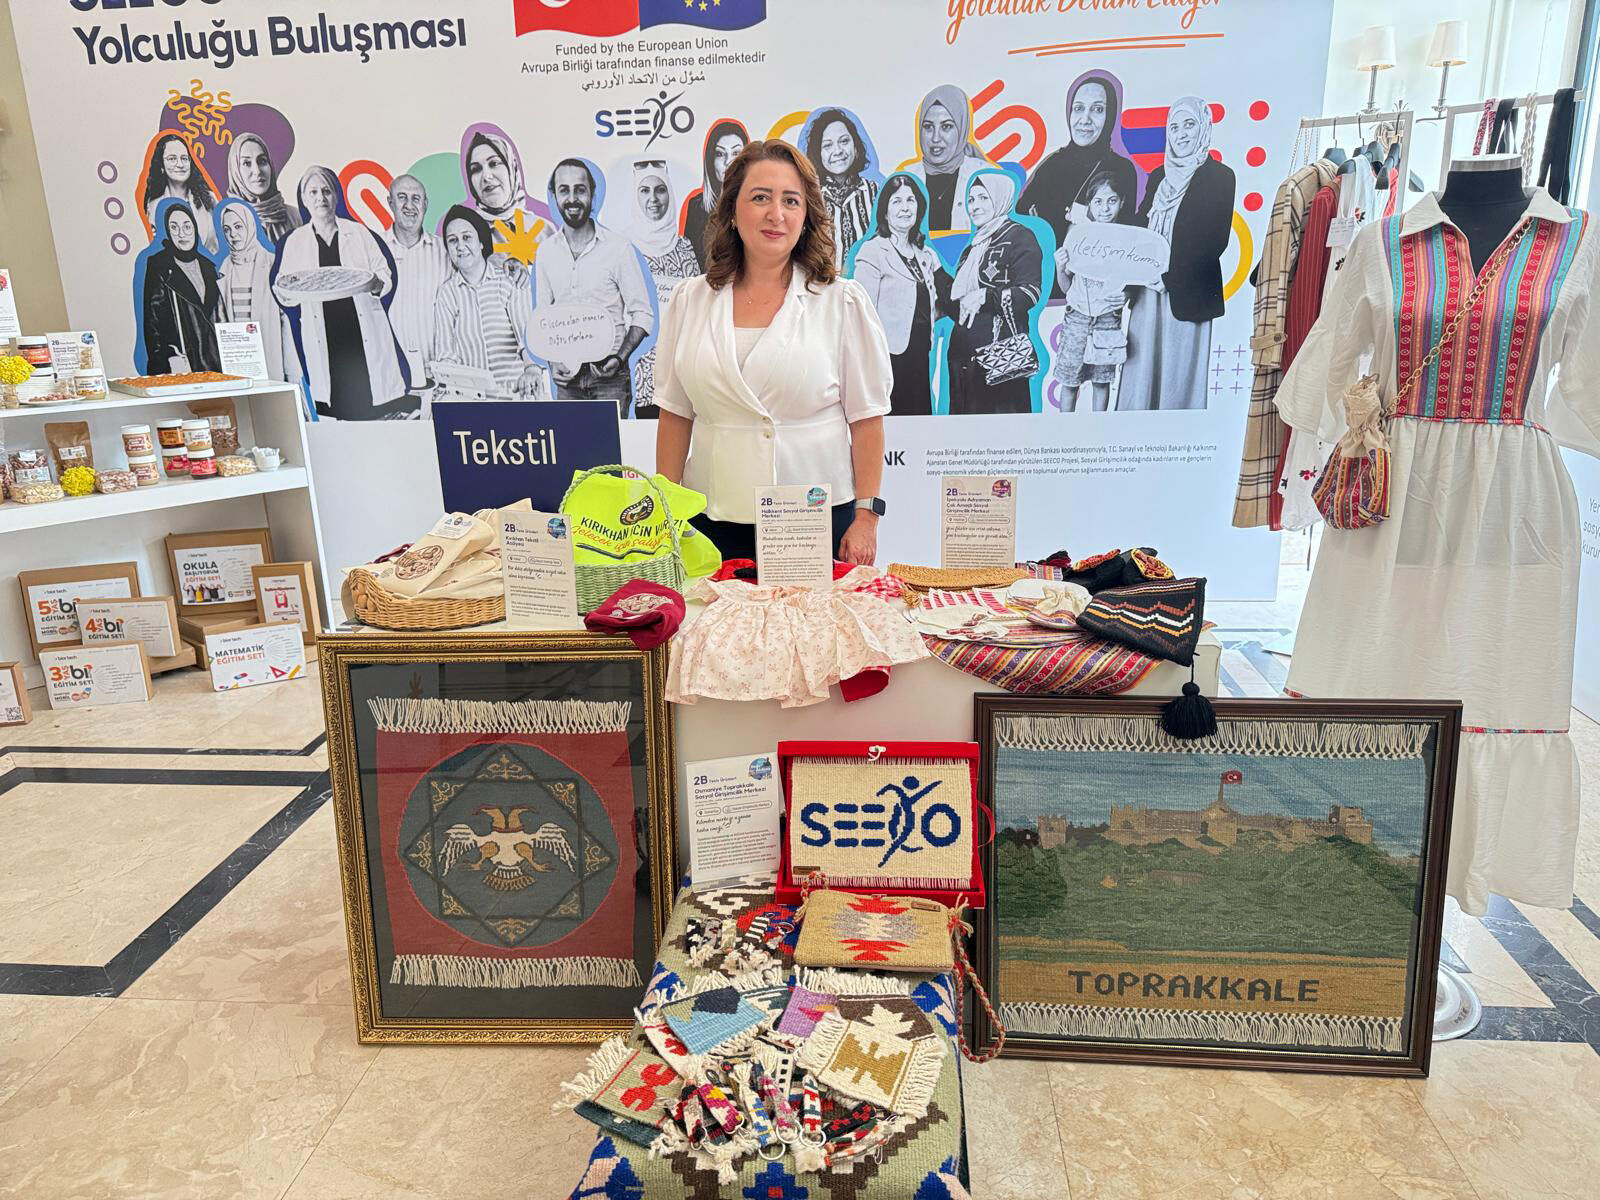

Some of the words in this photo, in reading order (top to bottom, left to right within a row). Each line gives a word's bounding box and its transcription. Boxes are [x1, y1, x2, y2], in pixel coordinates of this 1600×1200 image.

[73, 19, 259, 68] Yolculuğu
[267, 13, 467, 62] Buluşması
[555, 44, 597, 56] Funded
[600, 43, 613, 54] by
[617, 42, 634, 53] the
[638, 40, 692, 53] European
[696, 38, 728, 49] Union
[521, 62, 559, 74] Avrupa
[563, 60, 593, 73] Birliği
[596, 57, 651, 70] tarafından
[655, 55, 694, 67] finanse
[698, 52, 766, 65] edilmektedir
[582, 73, 624, 91] الأوروبي
[662, 73, 676, 85] من
[452, 429, 557, 465] Tekstil
[945, 449, 958, 457] Birliği
[1024, 447, 1040, 455] Dünya
[1118, 445, 1137, 454] Sanayi
[1144, 445, 1167, 453] Teknoloji
[946, 488, 958, 496] 2B
[761, 497, 773, 506] 2B
[504, 523, 516, 532] 2B
[580, 517, 629, 541] KIRIKHAN
[570, 525, 612, 547] Gelecek
[183, 561, 218, 571] OKULA
[37, 600, 52, 615] 5
[41, 614, 65, 622] EĞİTİM
[85, 618, 97, 632] 4
[215, 643, 264, 657] MATEMATİK
[217, 655, 246, 665] EĞİTİM
[247, 652, 265, 660] SETİ
[48, 666, 63, 681] 3
[693, 775, 708, 786] 2B
[714, 790, 743, 799] Girişimcilik
[1068, 970, 1320, 1002] TOPRAKKALE
